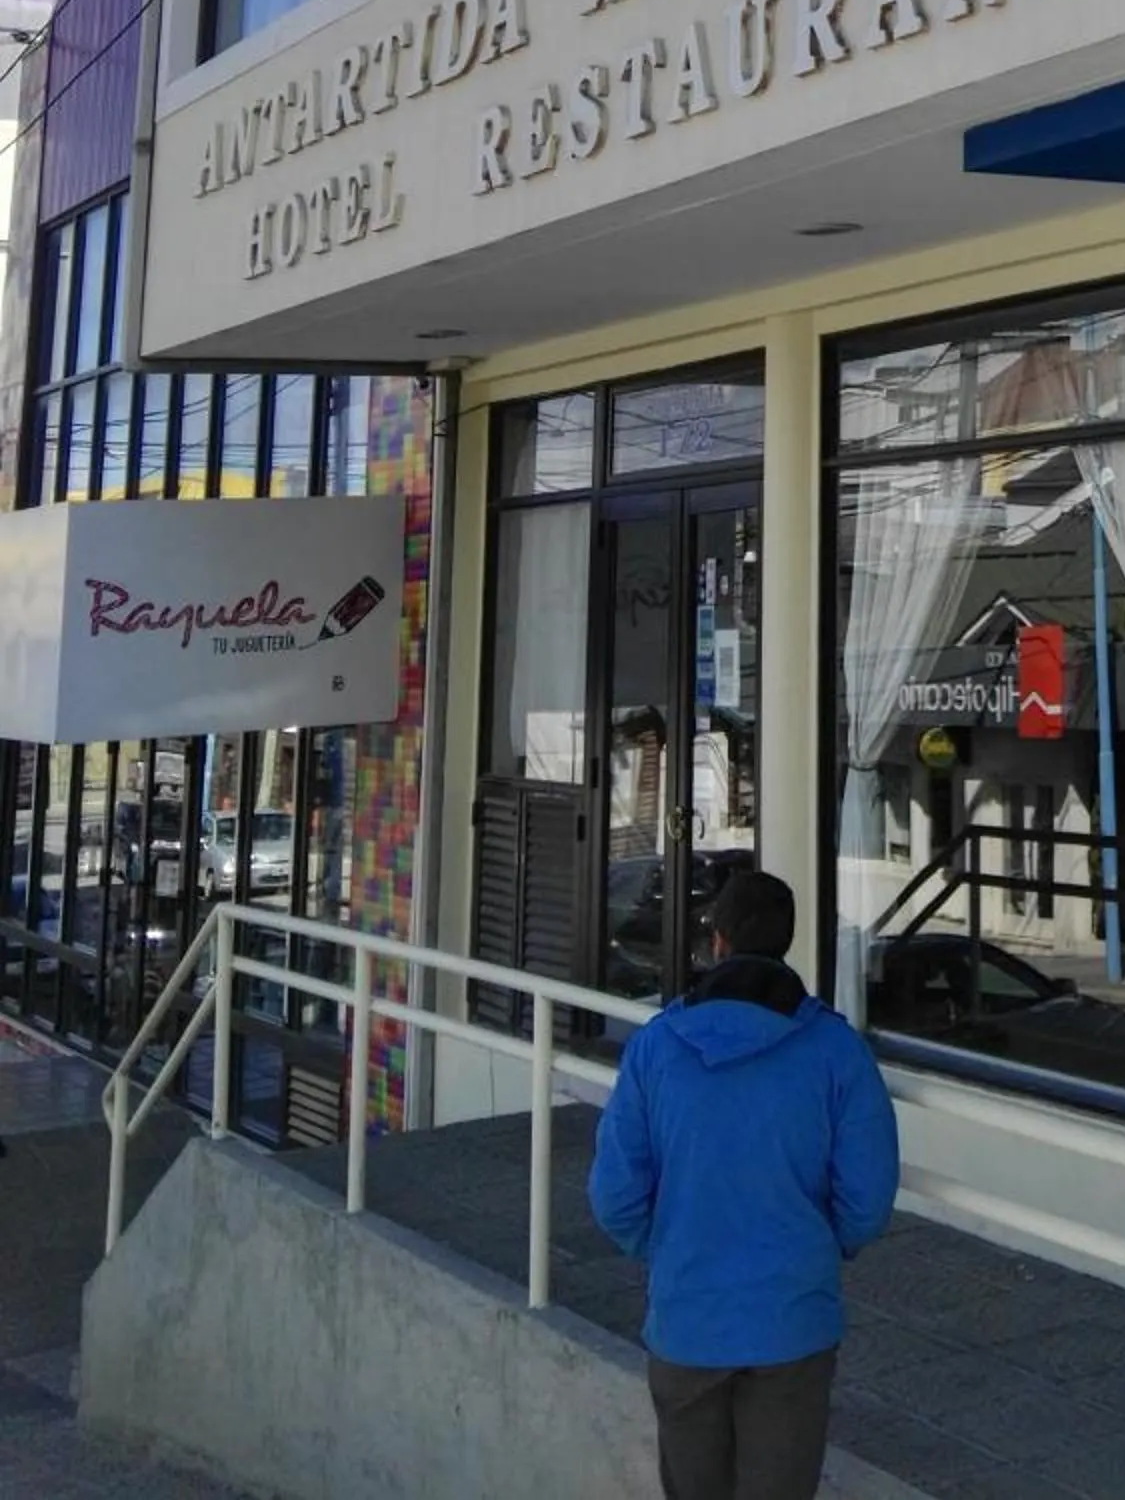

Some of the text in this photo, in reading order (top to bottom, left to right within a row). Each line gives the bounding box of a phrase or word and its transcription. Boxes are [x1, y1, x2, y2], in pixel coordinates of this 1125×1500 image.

[243, 149, 407, 281] HOTEL
[85, 578, 317, 649] Rayuela
[212, 636, 227, 655] TU
